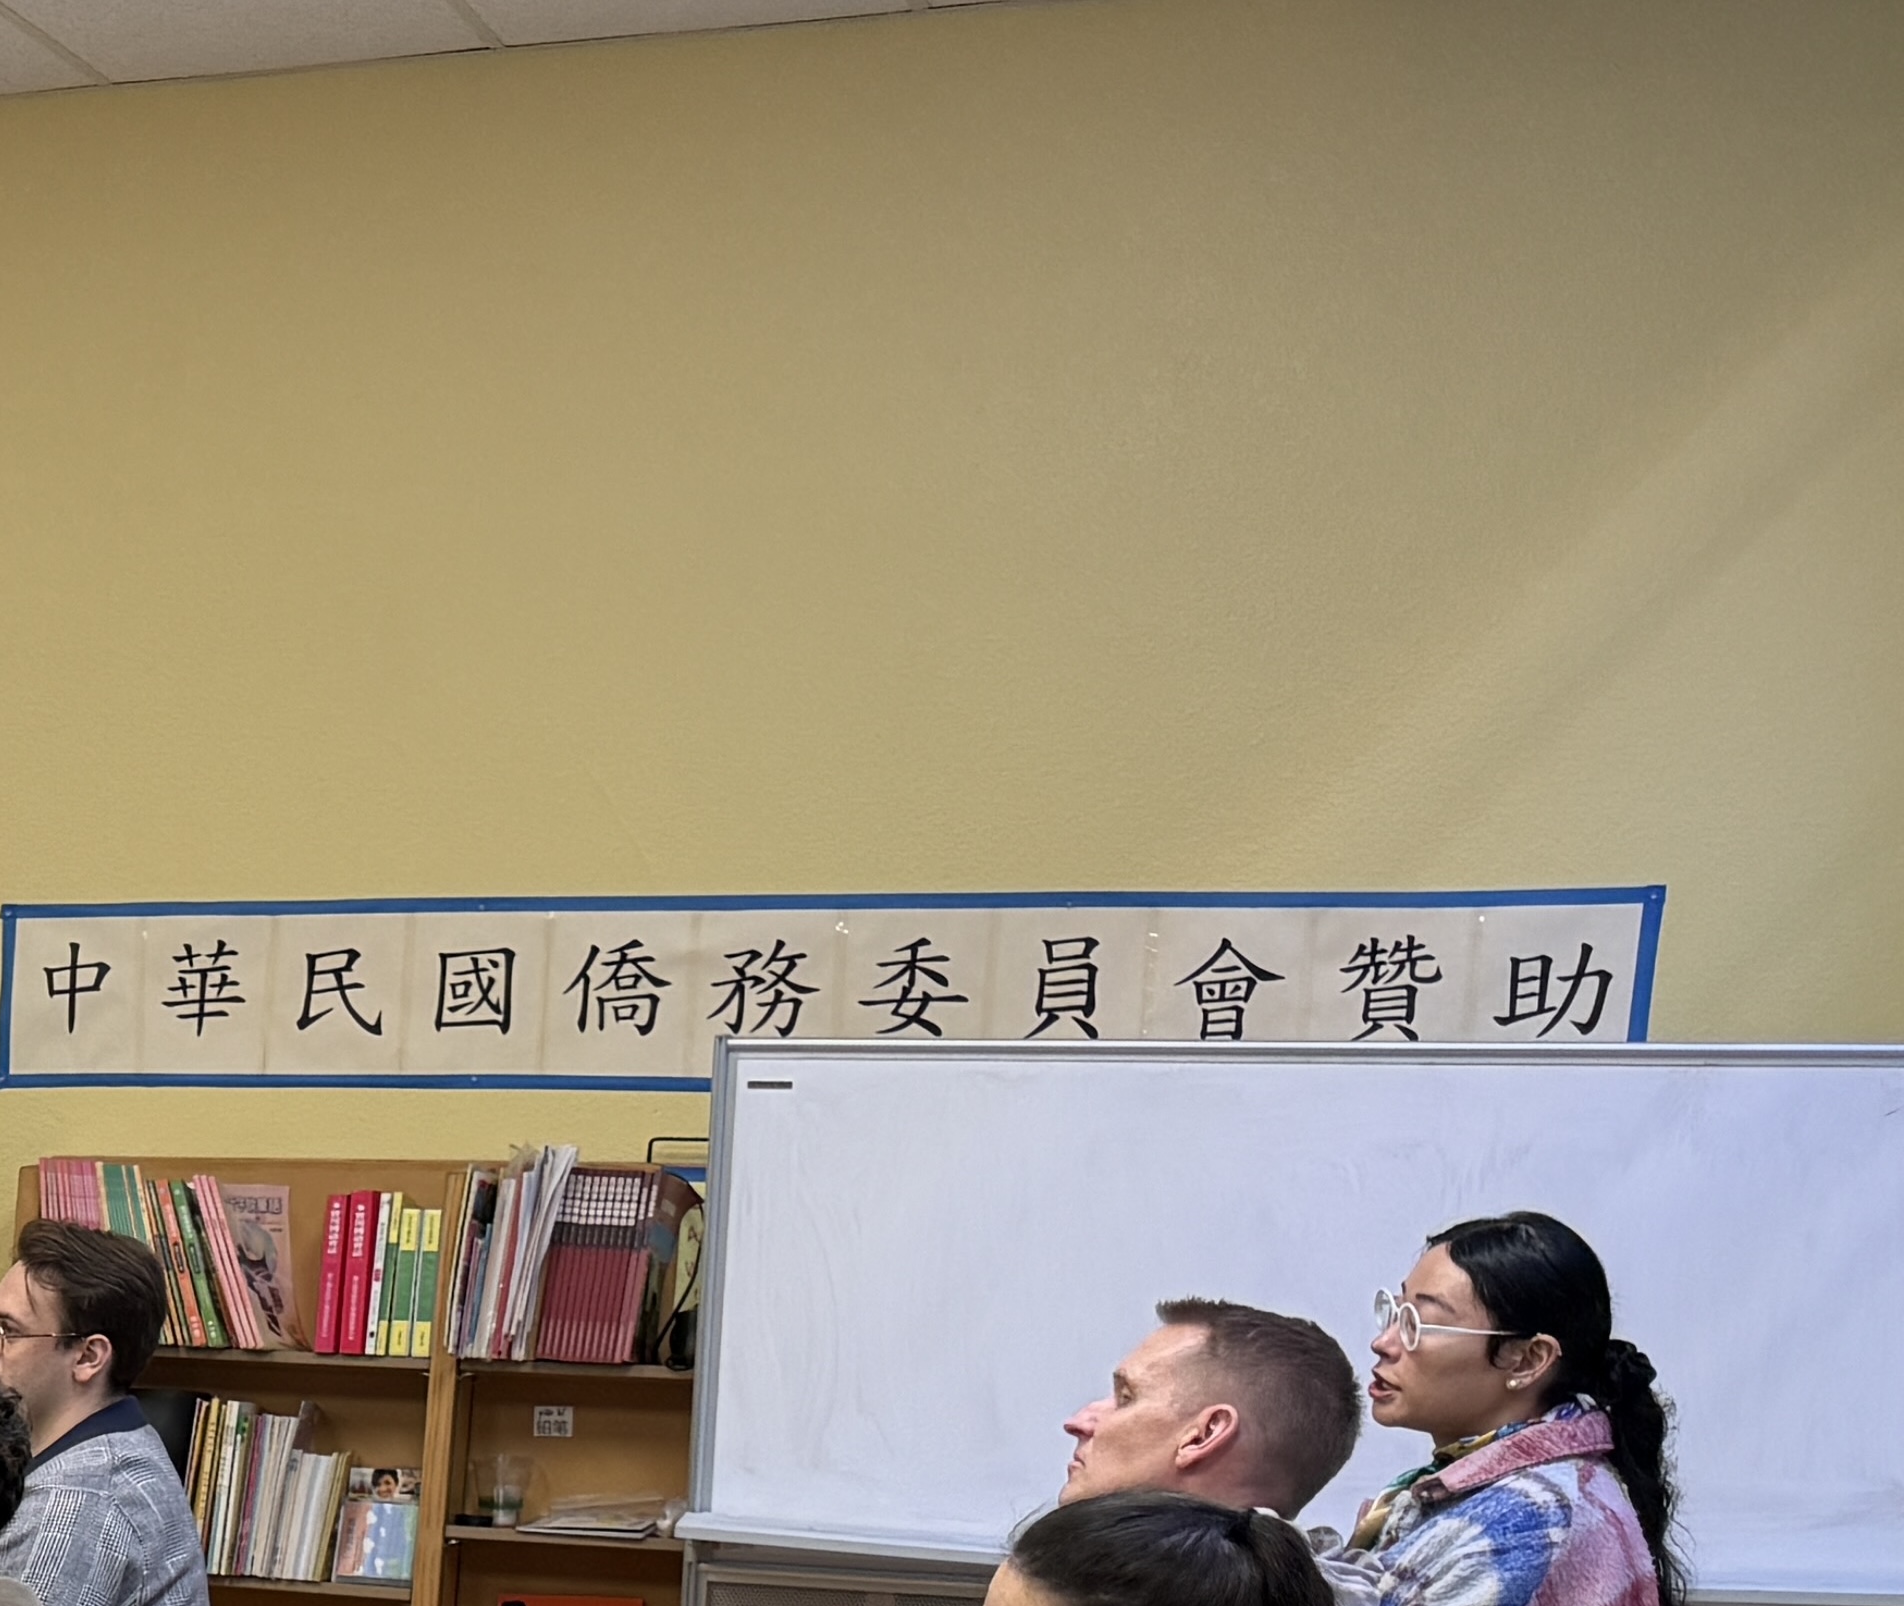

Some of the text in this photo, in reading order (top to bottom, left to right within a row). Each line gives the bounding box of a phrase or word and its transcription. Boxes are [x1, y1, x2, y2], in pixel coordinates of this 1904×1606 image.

[43, 933, 1614, 1042] 中華民國僑務委員會贊助
